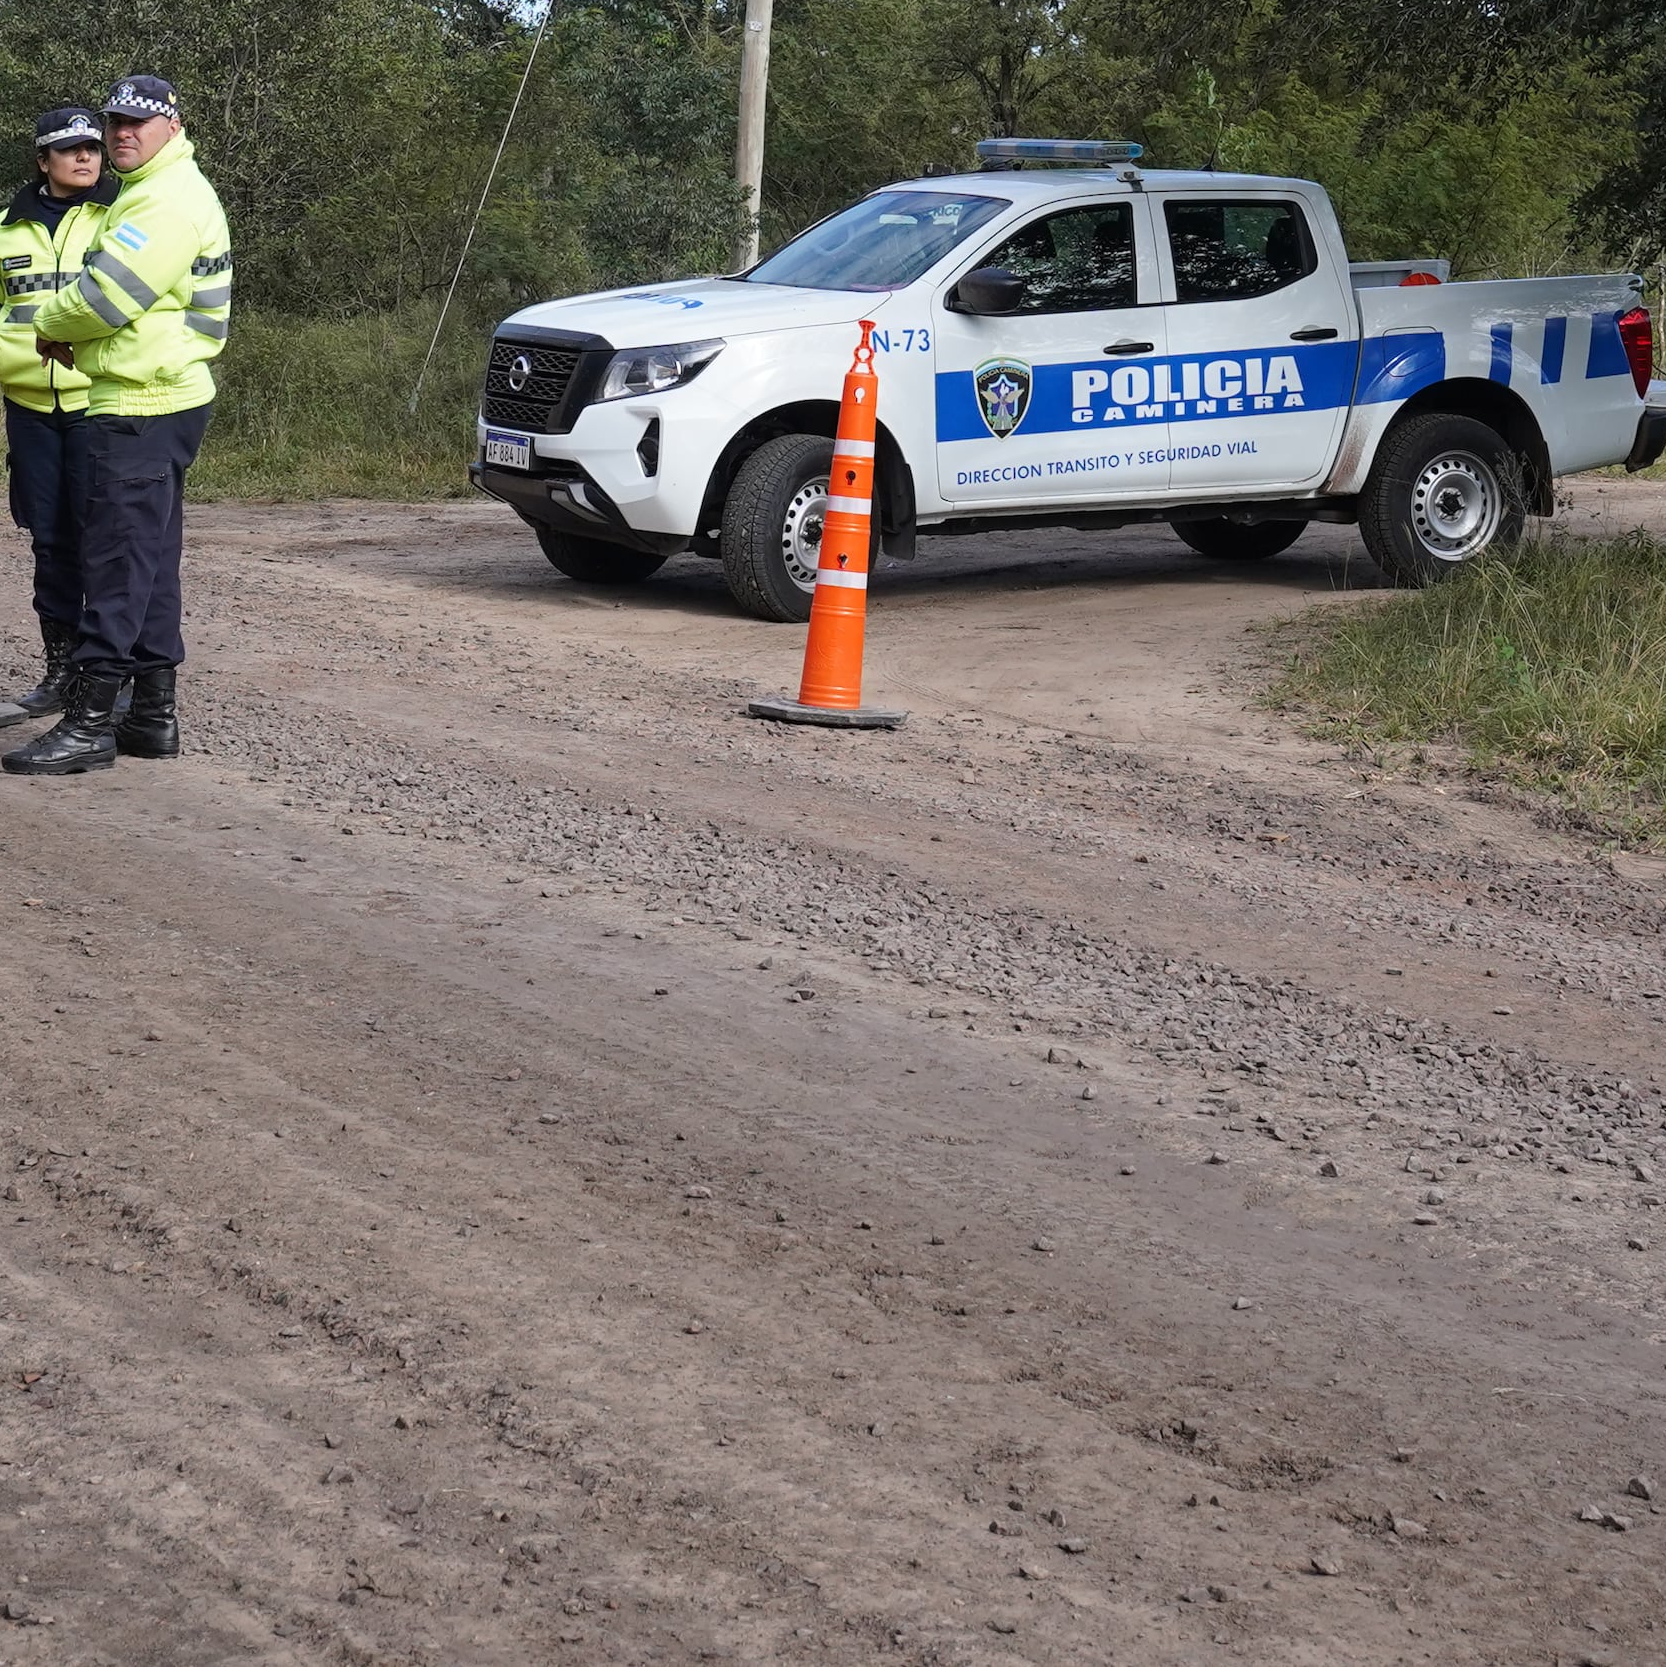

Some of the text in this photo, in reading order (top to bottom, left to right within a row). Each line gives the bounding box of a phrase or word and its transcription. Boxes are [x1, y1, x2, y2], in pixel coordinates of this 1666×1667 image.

[871, 329, 931, 353] N-73
[1071, 355, 1304, 409] POLICIA
[1071, 393, 1305, 423] CAMINERA
[488, 442, 498, 460] AF
[957, 440, 1258, 485] DIRECCION TRANSITO Y SEGURIDAD VIAL
